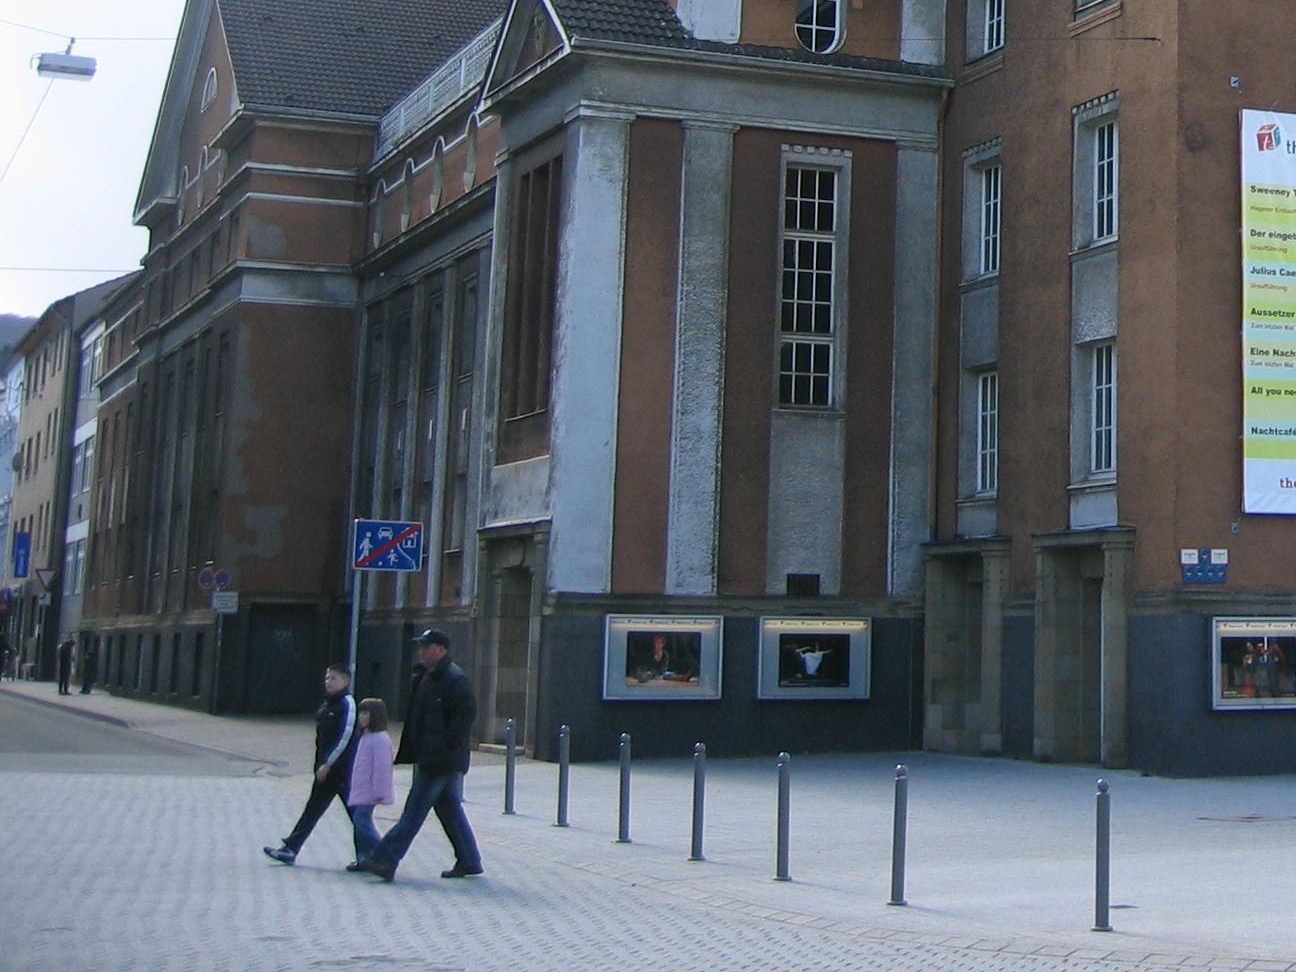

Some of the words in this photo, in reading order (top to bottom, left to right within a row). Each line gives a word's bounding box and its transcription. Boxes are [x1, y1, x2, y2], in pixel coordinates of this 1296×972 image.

[1250, 185, 1290, 198] Sweeney
[1250, 229, 1266, 238] Der
[1250, 266, 1276, 276] Julius
[1250, 308, 1295, 318] Aussetzer
[1250, 348, 1270, 356] Eine
[1250, 386, 1263, 395] All
[1265, 388, 1282, 397] you
